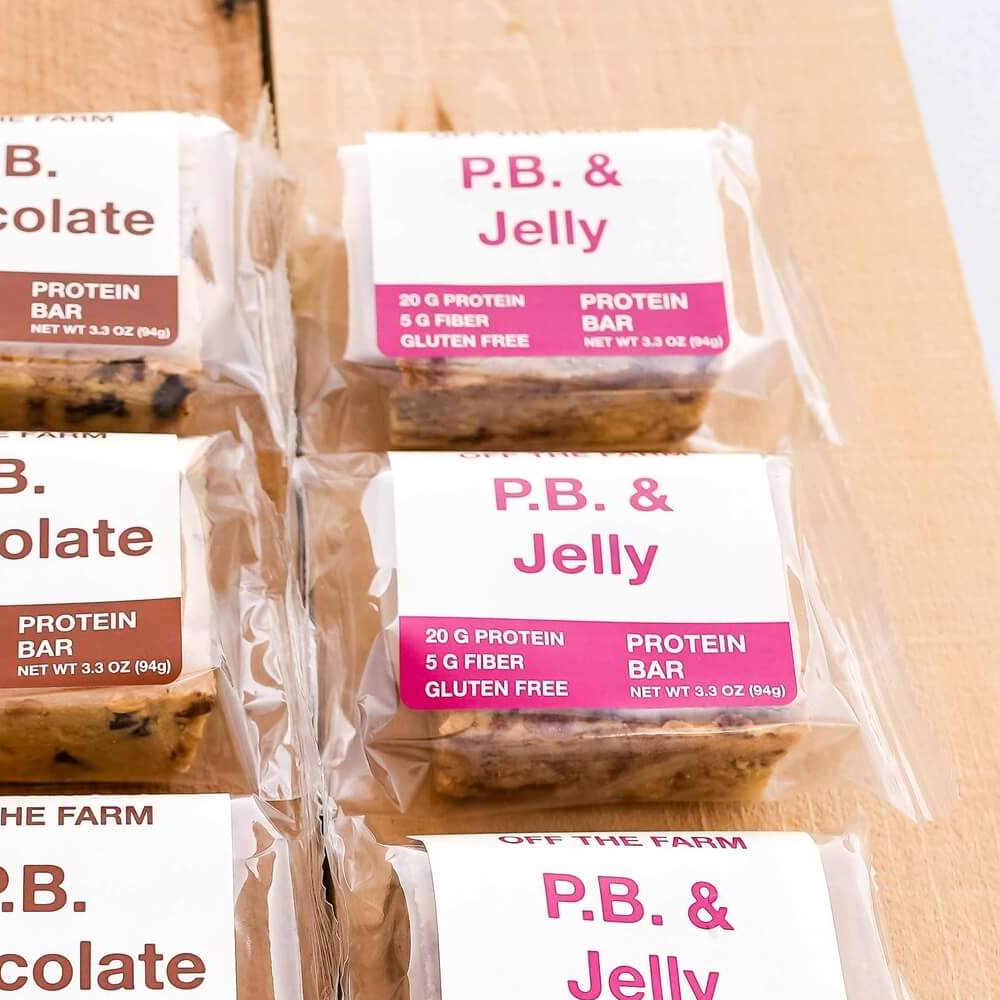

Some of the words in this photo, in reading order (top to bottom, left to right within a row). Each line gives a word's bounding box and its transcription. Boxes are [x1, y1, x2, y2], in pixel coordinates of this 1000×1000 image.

[462, 155, 561, 189] P.B.
[584, 153, 622, 188] &
[478, 209, 608, 254] Jelly
[31, 281, 140, 301] PROTEIN
[579, 292, 689, 311] PROTEIN
[30, 302, 82, 320] BAR
[581, 314, 634, 332] BAR
[400, 333, 477, 348] GLUTEN
[480, 333, 530, 348] FREE
[493, 477, 606, 512] P.B.
[629, 477, 674, 513] &
[513, 533, 659, 586] Jelly
[18, 611, 137, 634] PROTEIN
[17, 638, 73, 659] BAR
[626, 633, 746, 654] PROTEIN
[17, 664, 49, 677] NET
[52, 662, 78, 675] WT
[81, 661, 104, 674] 3.3
[108, 660, 131, 674] OZ
[134, 659, 171, 675] (94g)
[628, 659, 685, 680] BAR
[425, 679, 509, 698] GLUTEN
[515, 679, 569, 697] FREE
[630, 686, 661, 698] NET
[665, 685, 691, 698] WT
[694, 685, 718, 697] 3.3
[721, 684, 745, 697] OZ
[748, 684, 786, 698] (94g)
[57, 805, 154, 826] FARM
[498, 835, 562, 845] OFF
[572, 835, 644, 847] THE
[649, 836, 748, 850] FARM
[542, 872, 664, 927] P.B.
[687, 880, 735, 931] &
